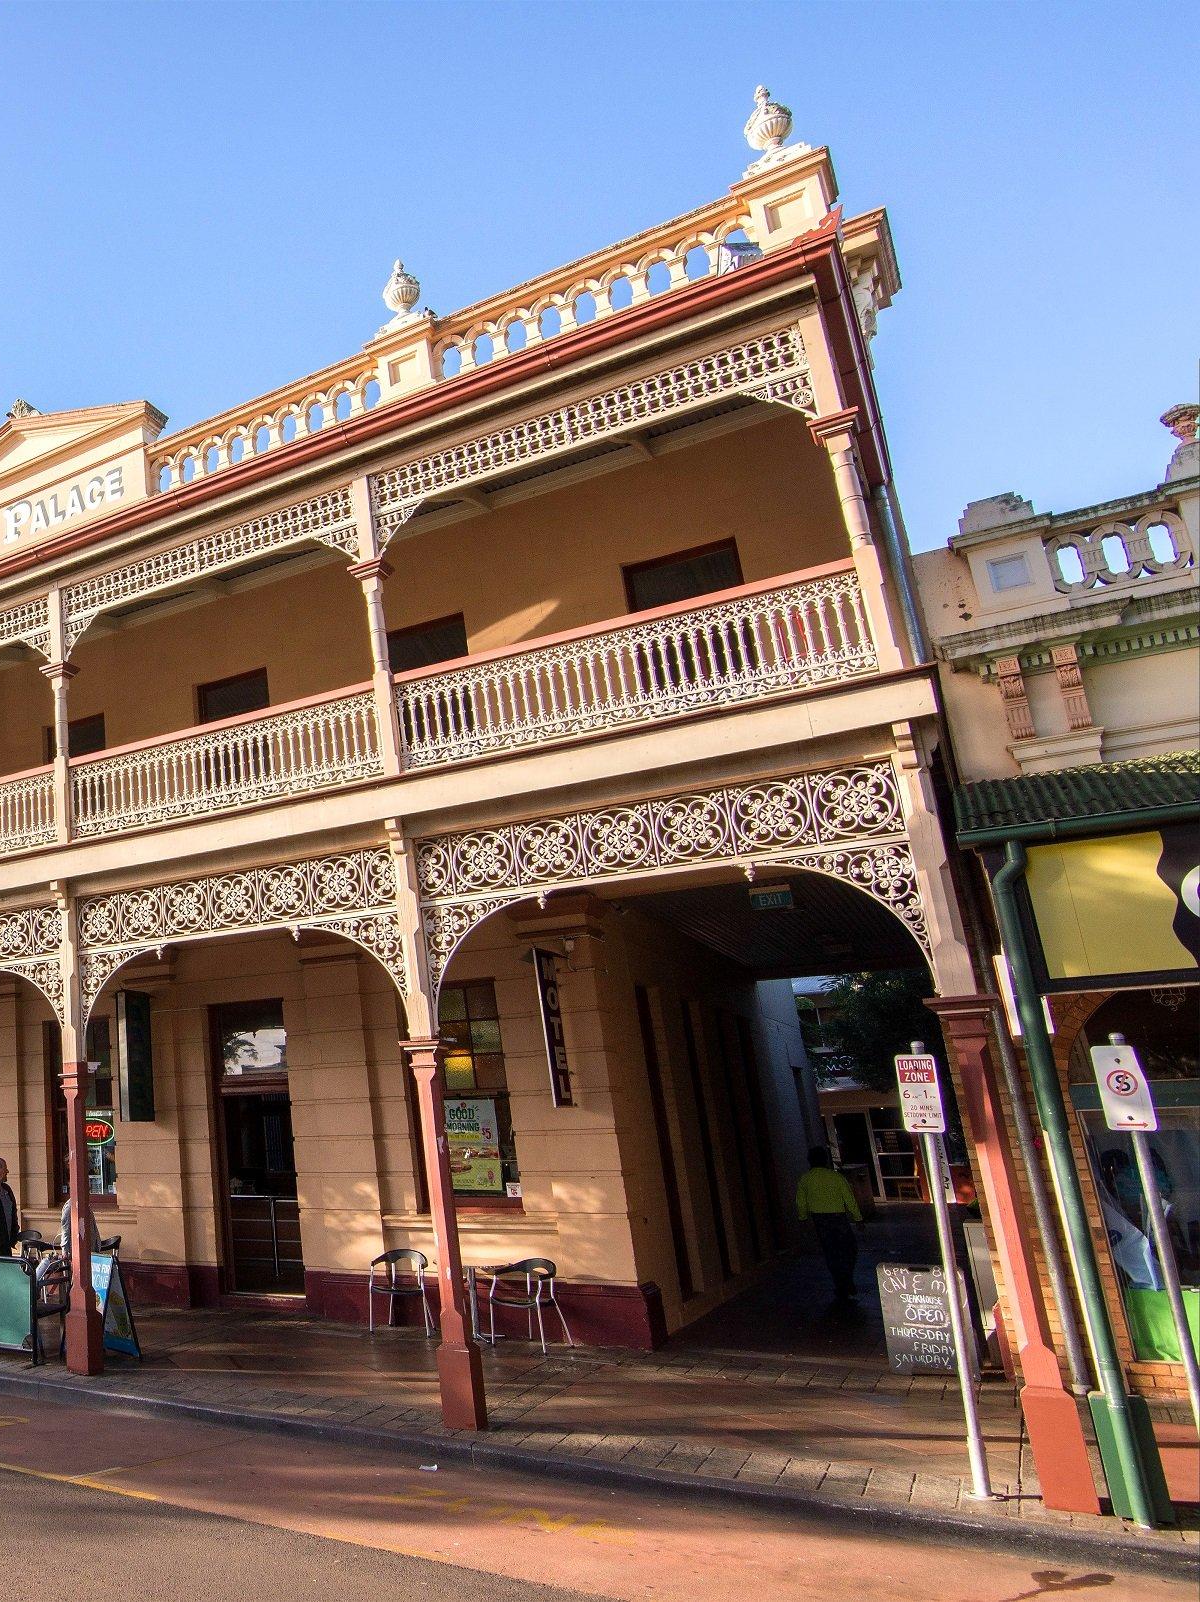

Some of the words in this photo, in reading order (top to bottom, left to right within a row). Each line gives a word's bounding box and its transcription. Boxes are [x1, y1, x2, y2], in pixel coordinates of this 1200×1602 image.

[2, 466, 124, 545] PALACE
[758, 893, 782, 907] EXIT
[542, 956, 571, 1099] HOTEL
[898, 1060, 932, 1070] LOADING
[904, 1072, 930, 1082] ZONE
[449, 1107, 475, 1120] GOOD
[86, 1124, 109, 1138] PEN
[446, 1122, 480, 1132] MORNING
[481, 1127, 492, 1140] $5
[900, 1293, 944, 1306] STEAKHOUSE
[905, 1307, 945, 1323] OPEN
[889, 1326, 951, 1344] THURSDAY
[913, 1342, 956, 1357] FRIDAY
[895, 1354, 950, 1368] SATURDAY
